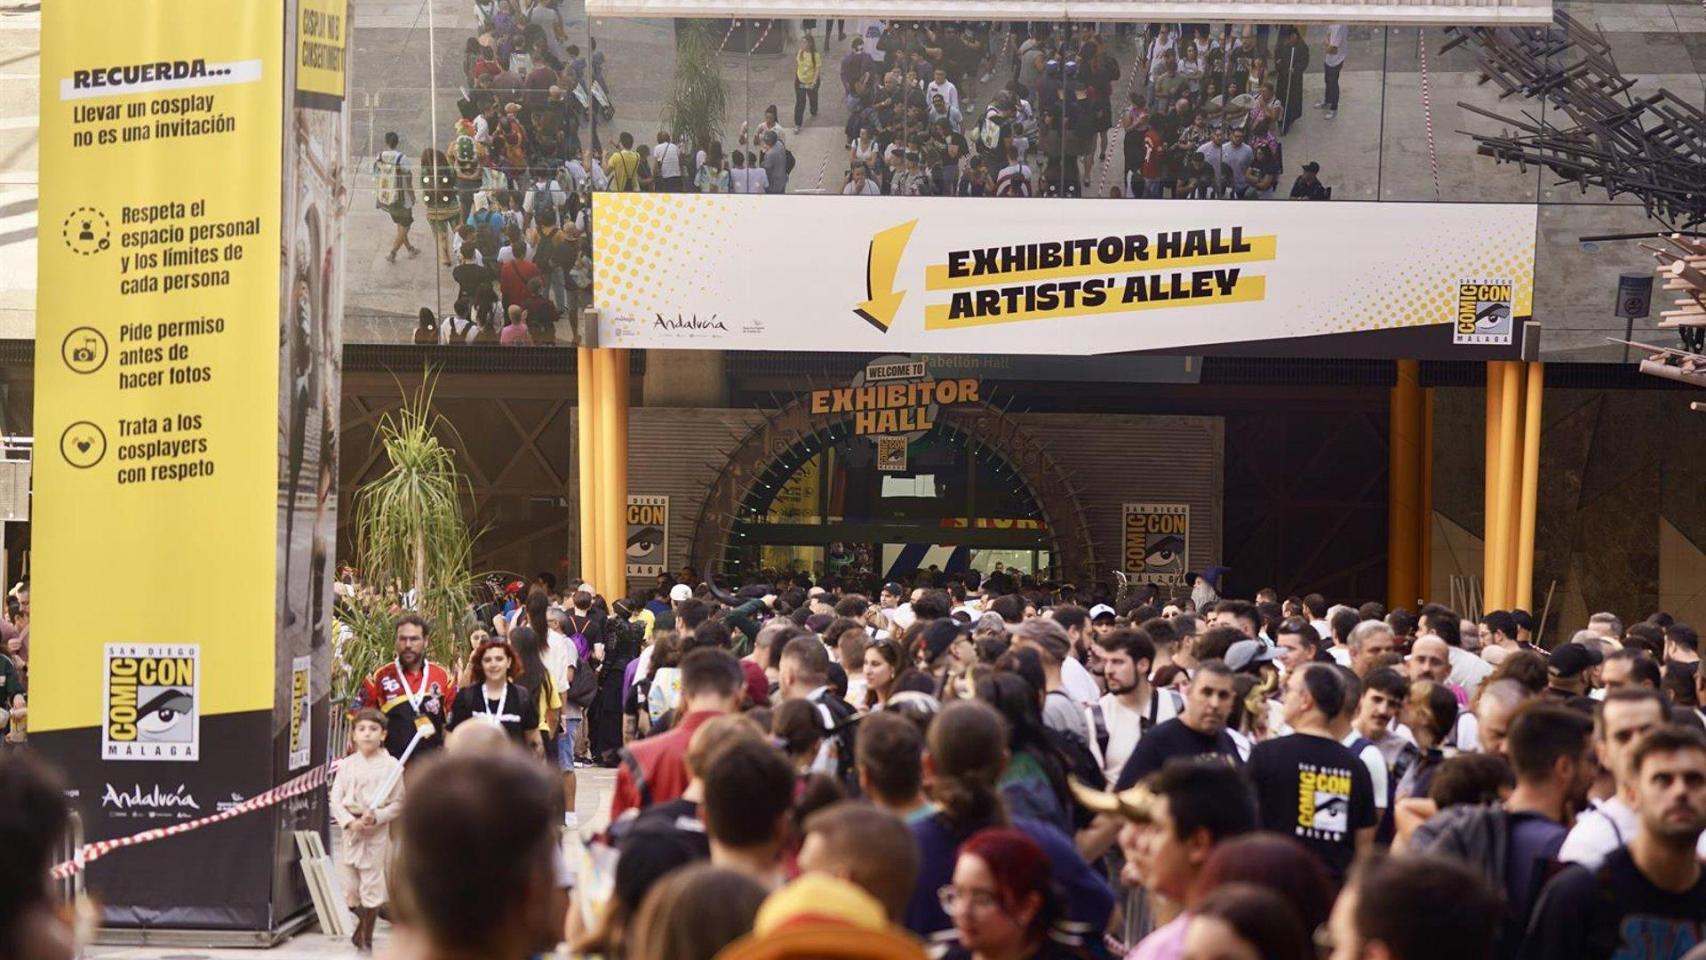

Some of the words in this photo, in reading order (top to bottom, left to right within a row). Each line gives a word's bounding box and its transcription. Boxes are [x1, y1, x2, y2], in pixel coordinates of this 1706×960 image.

[73, 59, 231, 89] RECUERDA...
[73, 103, 122, 124] Llevar
[127, 102, 146, 119] un
[151, 95, 214, 116] cosplay
[73, 130, 93, 147] no
[98, 128, 117, 145] es
[122, 123, 151, 143] una
[155, 113, 235, 138] invitación
[121, 201, 186, 225] Respeta
[190, 199, 205, 217] el
[121, 224, 184, 248] espacio
[189, 217, 260, 244] personal
[121, 256, 130, 274] y
[134, 252, 158, 270] los
[163, 246, 219, 267] límites
[224, 243, 243, 261] de
[948, 235, 1149, 279] EXHIBITOR
[1156, 226, 1251, 260] HALL
[121, 275, 158, 295] cada
[163, 270, 230, 294] persona
[948, 278, 1116, 320] ARTISTS'
[1121, 268, 1241, 304] ALLEY
[1478, 285, 1511, 302] CON
[653, 313, 728, 331] Andalucía
[1458, 285, 1477, 334] COMIC
[120, 322, 152, 343] Pide
[157, 316, 225, 341] permiso
[119, 347, 163, 366] antes
[168, 343, 189, 361] de
[119, 371, 164, 390] hacer
[169, 365, 211, 385] fotos
[869, 365, 910, 378] WELCOME
[912, 364, 923, 375] TO
[811, 378, 980, 414] EXHIBITOR
[118, 417, 157, 437] Trata
[162, 417, 172, 433] a
[177, 413, 202, 431] los
[855, 407, 933, 435] HALL
[118, 438, 208, 461] cosplayers
[117, 467, 146, 484] con
[151, 459, 214, 481] respeto
[628, 506, 664, 525] CON
[1147, 515, 1185, 533] CON
[1127, 515, 1146, 572] COMIC
[627, 566, 663, 574] LAGA
[140, 658, 193, 686] CON
[109, 658, 138, 741] COMIC
[102, 782, 200, 809] Andalucía
[1316, 774, 1351, 795] CON
[1298, 772, 1316, 827] COMIC
[1611, 914, 1706, 960] STA
